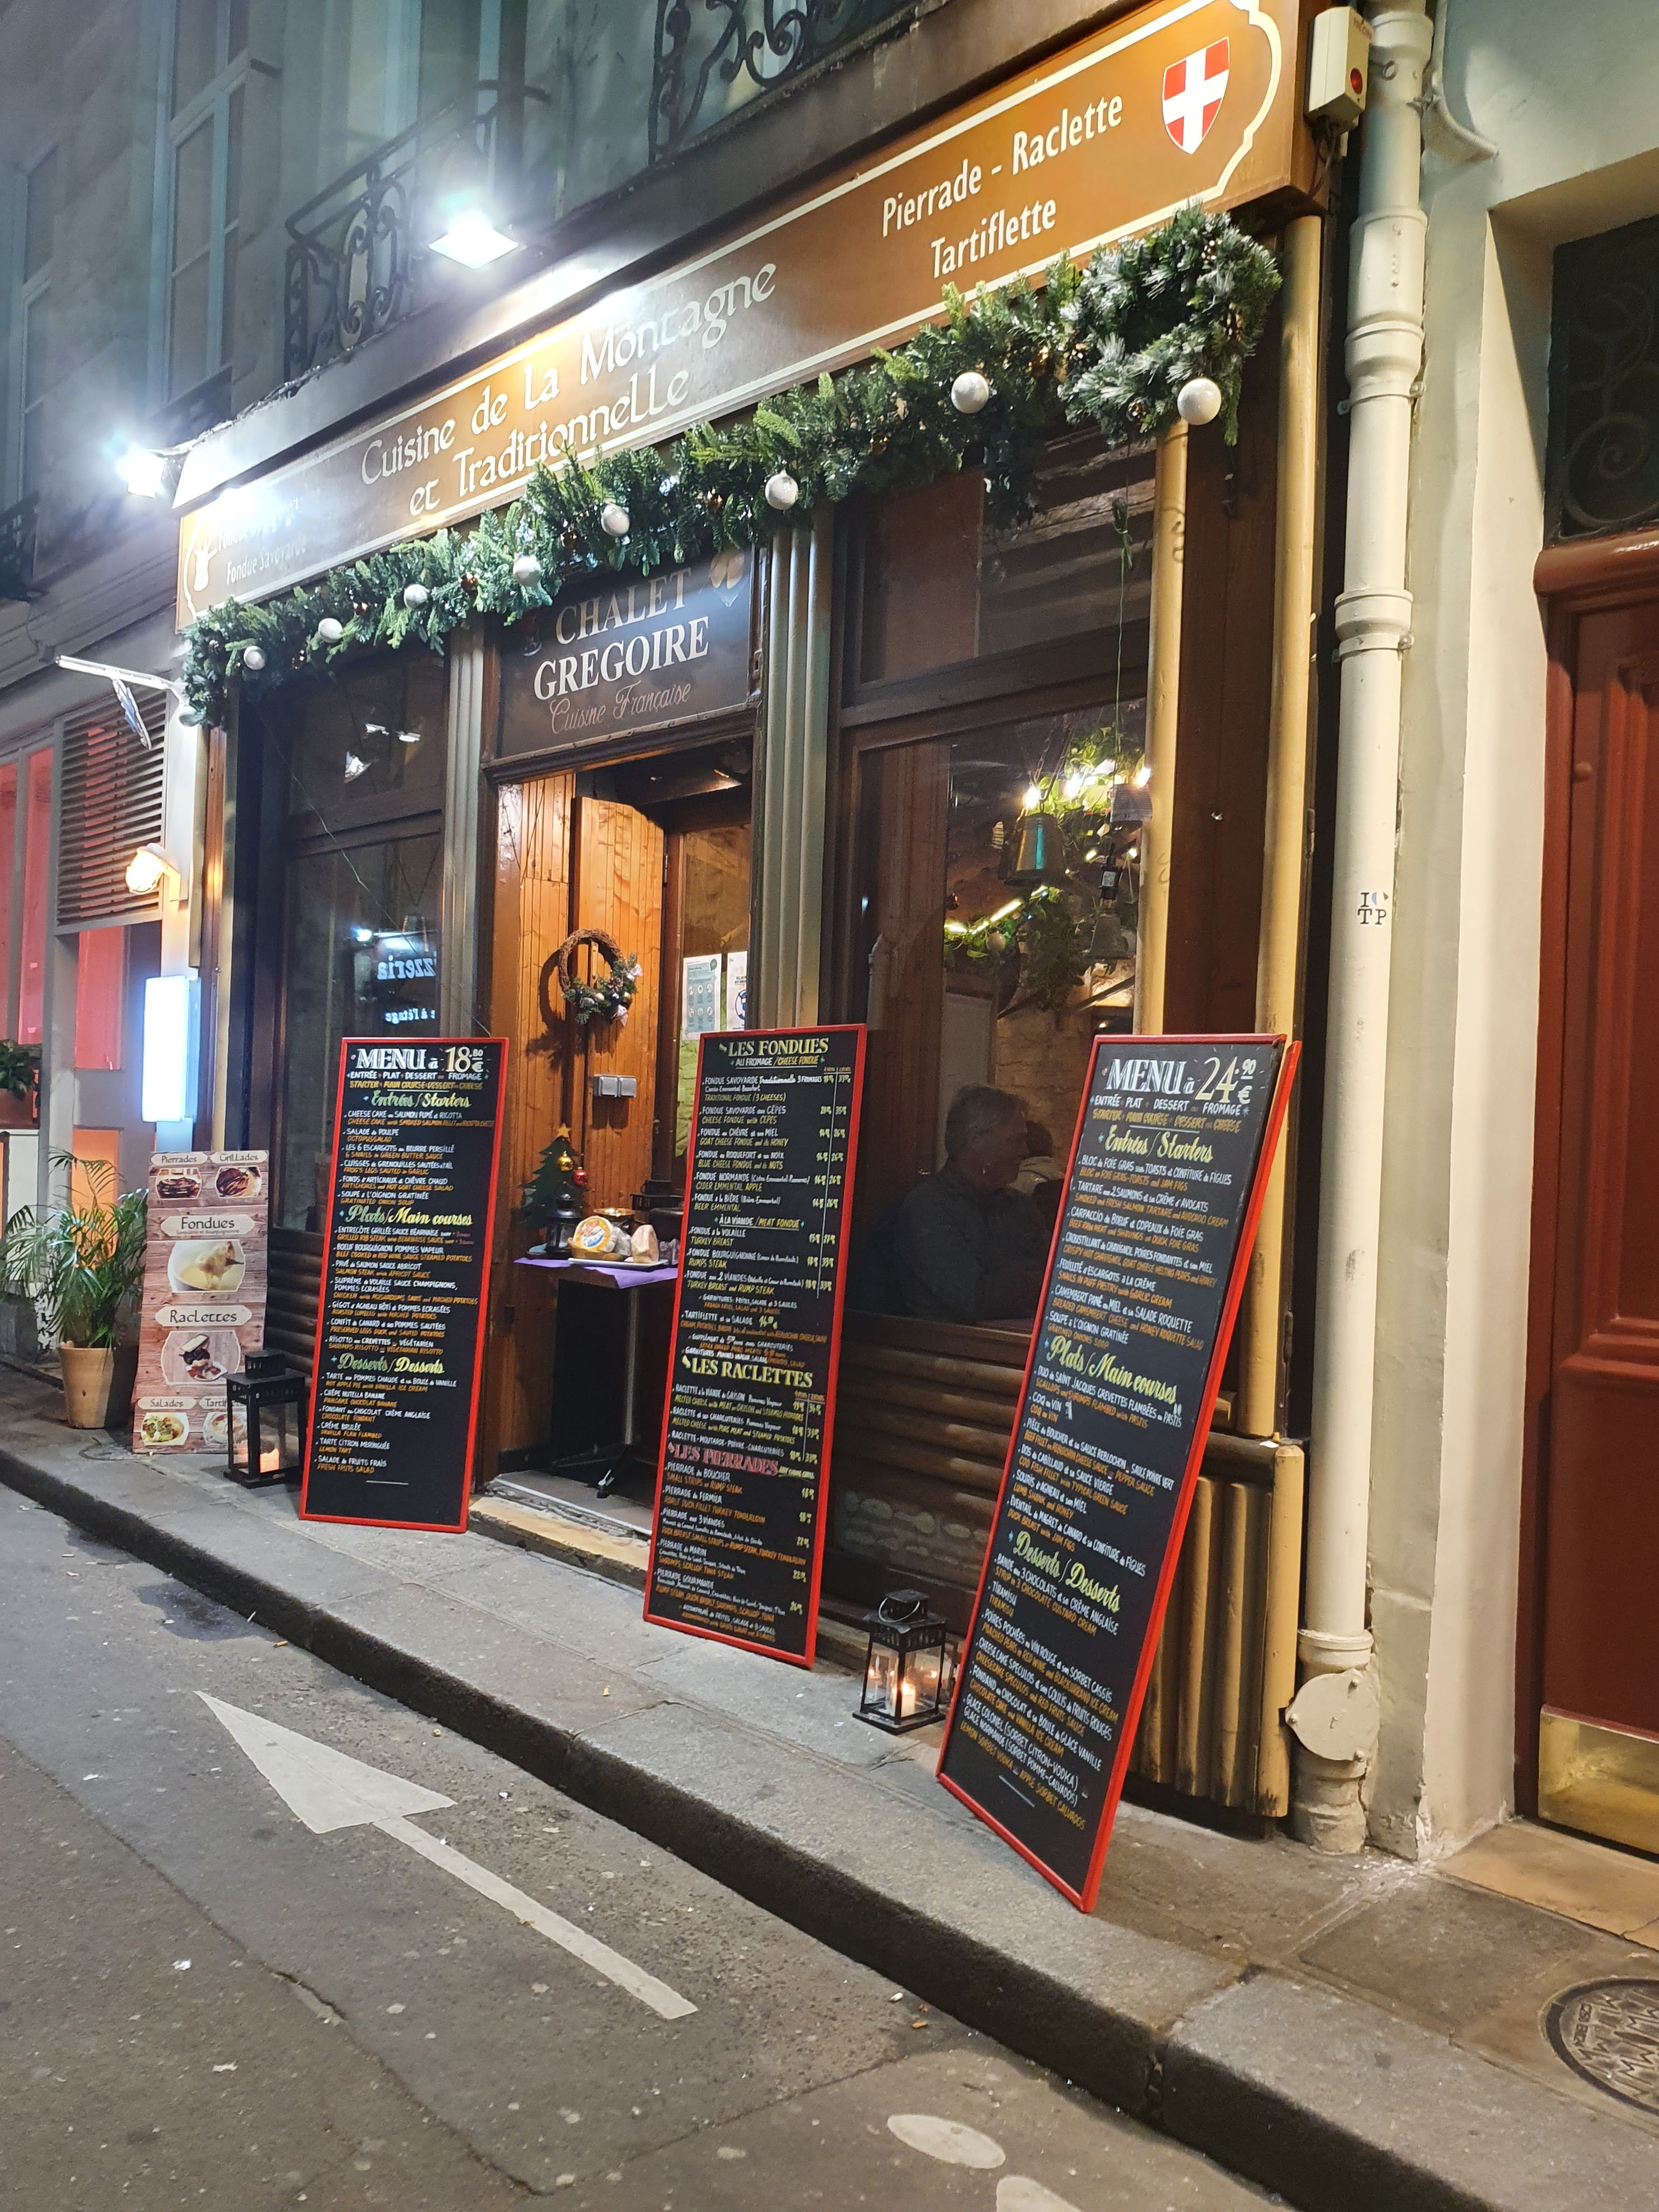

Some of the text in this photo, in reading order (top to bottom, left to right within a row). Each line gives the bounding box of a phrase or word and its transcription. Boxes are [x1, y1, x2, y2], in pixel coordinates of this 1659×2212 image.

[881, 158, 983, 237] Pierrade
[1012, 94, 1122, 176] Raclette
[931, 196, 1057, 279] Tartiflette
[362, 418, 455, 485] Cuisine
[471, 385, 507, 437] de
[579, 263, 777, 385] Montagne
[409, 369, 690, 516] et Traditionnelle
[226, 555, 257, 585] Fondue
[555, 567, 692, 645] CHALET
[534, 616, 710, 701] GREGOIRE
[550, 680, 692, 735] Cuisine Française
[356, 1048, 426, 1069] MENU
[728, 1037, 828, 1057] LES FONDUES
[735, 1058, 745, 1066] AU
[745, 1057, 772, 1066] FROMAGE
[349, 1070, 482, 1080] ENTRÉE PLAT DESSERT FROMAGE
[704, 1075, 758, 1085] FONDUE SAVOYARDE
[1106, 1059, 1185, 1094] MENU
[1183, 1076, 1195, 1094] à
[702, 1105, 755, 1114] FONDUE SAVOYARDE
[1094, 1093, 1242, 1116] ENTRÉE PLAT DESSERT FROMAGE
[700, 1127, 720, 1136] FONDUE
[220, 1153, 258, 1161] Grillades
[1081, 1154, 1097, 1166] BLOC
[1118, 1159, 1134, 1171] GRAS
[1143, 1163, 1166, 1176] TOASTS
[1077, 1180, 1103, 1194] TARTARE
[1180, 1198, 1208, 1212] AVOCATS
[181, 1216, 235, 1229] Fondues
[432, 1214, 472, 1225] courses
[1070, 1206, 1103, 1222] CARPACCIO
[1136, 1219, 1163, 1233] COPEAUX
[1186, 1229, 1203, 1242] GRAS
[170, 1310, 237, 1323] Raclettes
[1049, 1310, 1069, 1325] SOUPE
[1054, 1284, 1088, 1302] CAMEMBERT
[1135, 1306, 1158, 1323] SALADE
[1158, 1312, 1193, 1333] ROQUETTE
[692, 1357, 812, 1387] LES RACLETTES
[1037, 1365, 1049, 1378] DUO
[1097, 1387, 1127, 1407] CREVETTES
[1133, 1375, 1176, 1404] courses
[1032, 1391, 1045, 1406] COQ
[673, 1444, 700, 1461] LES
[1080, 1441, 1097, 1457] SAUCE
[1021, 1443, 1031, 1456] DOS
[1075, 1469, 1093, 1485] SAUCE
[1025, 1570, 1057, 1598] CHOCOLATS
[1069, 1666, 1091, 1689] SORBET
